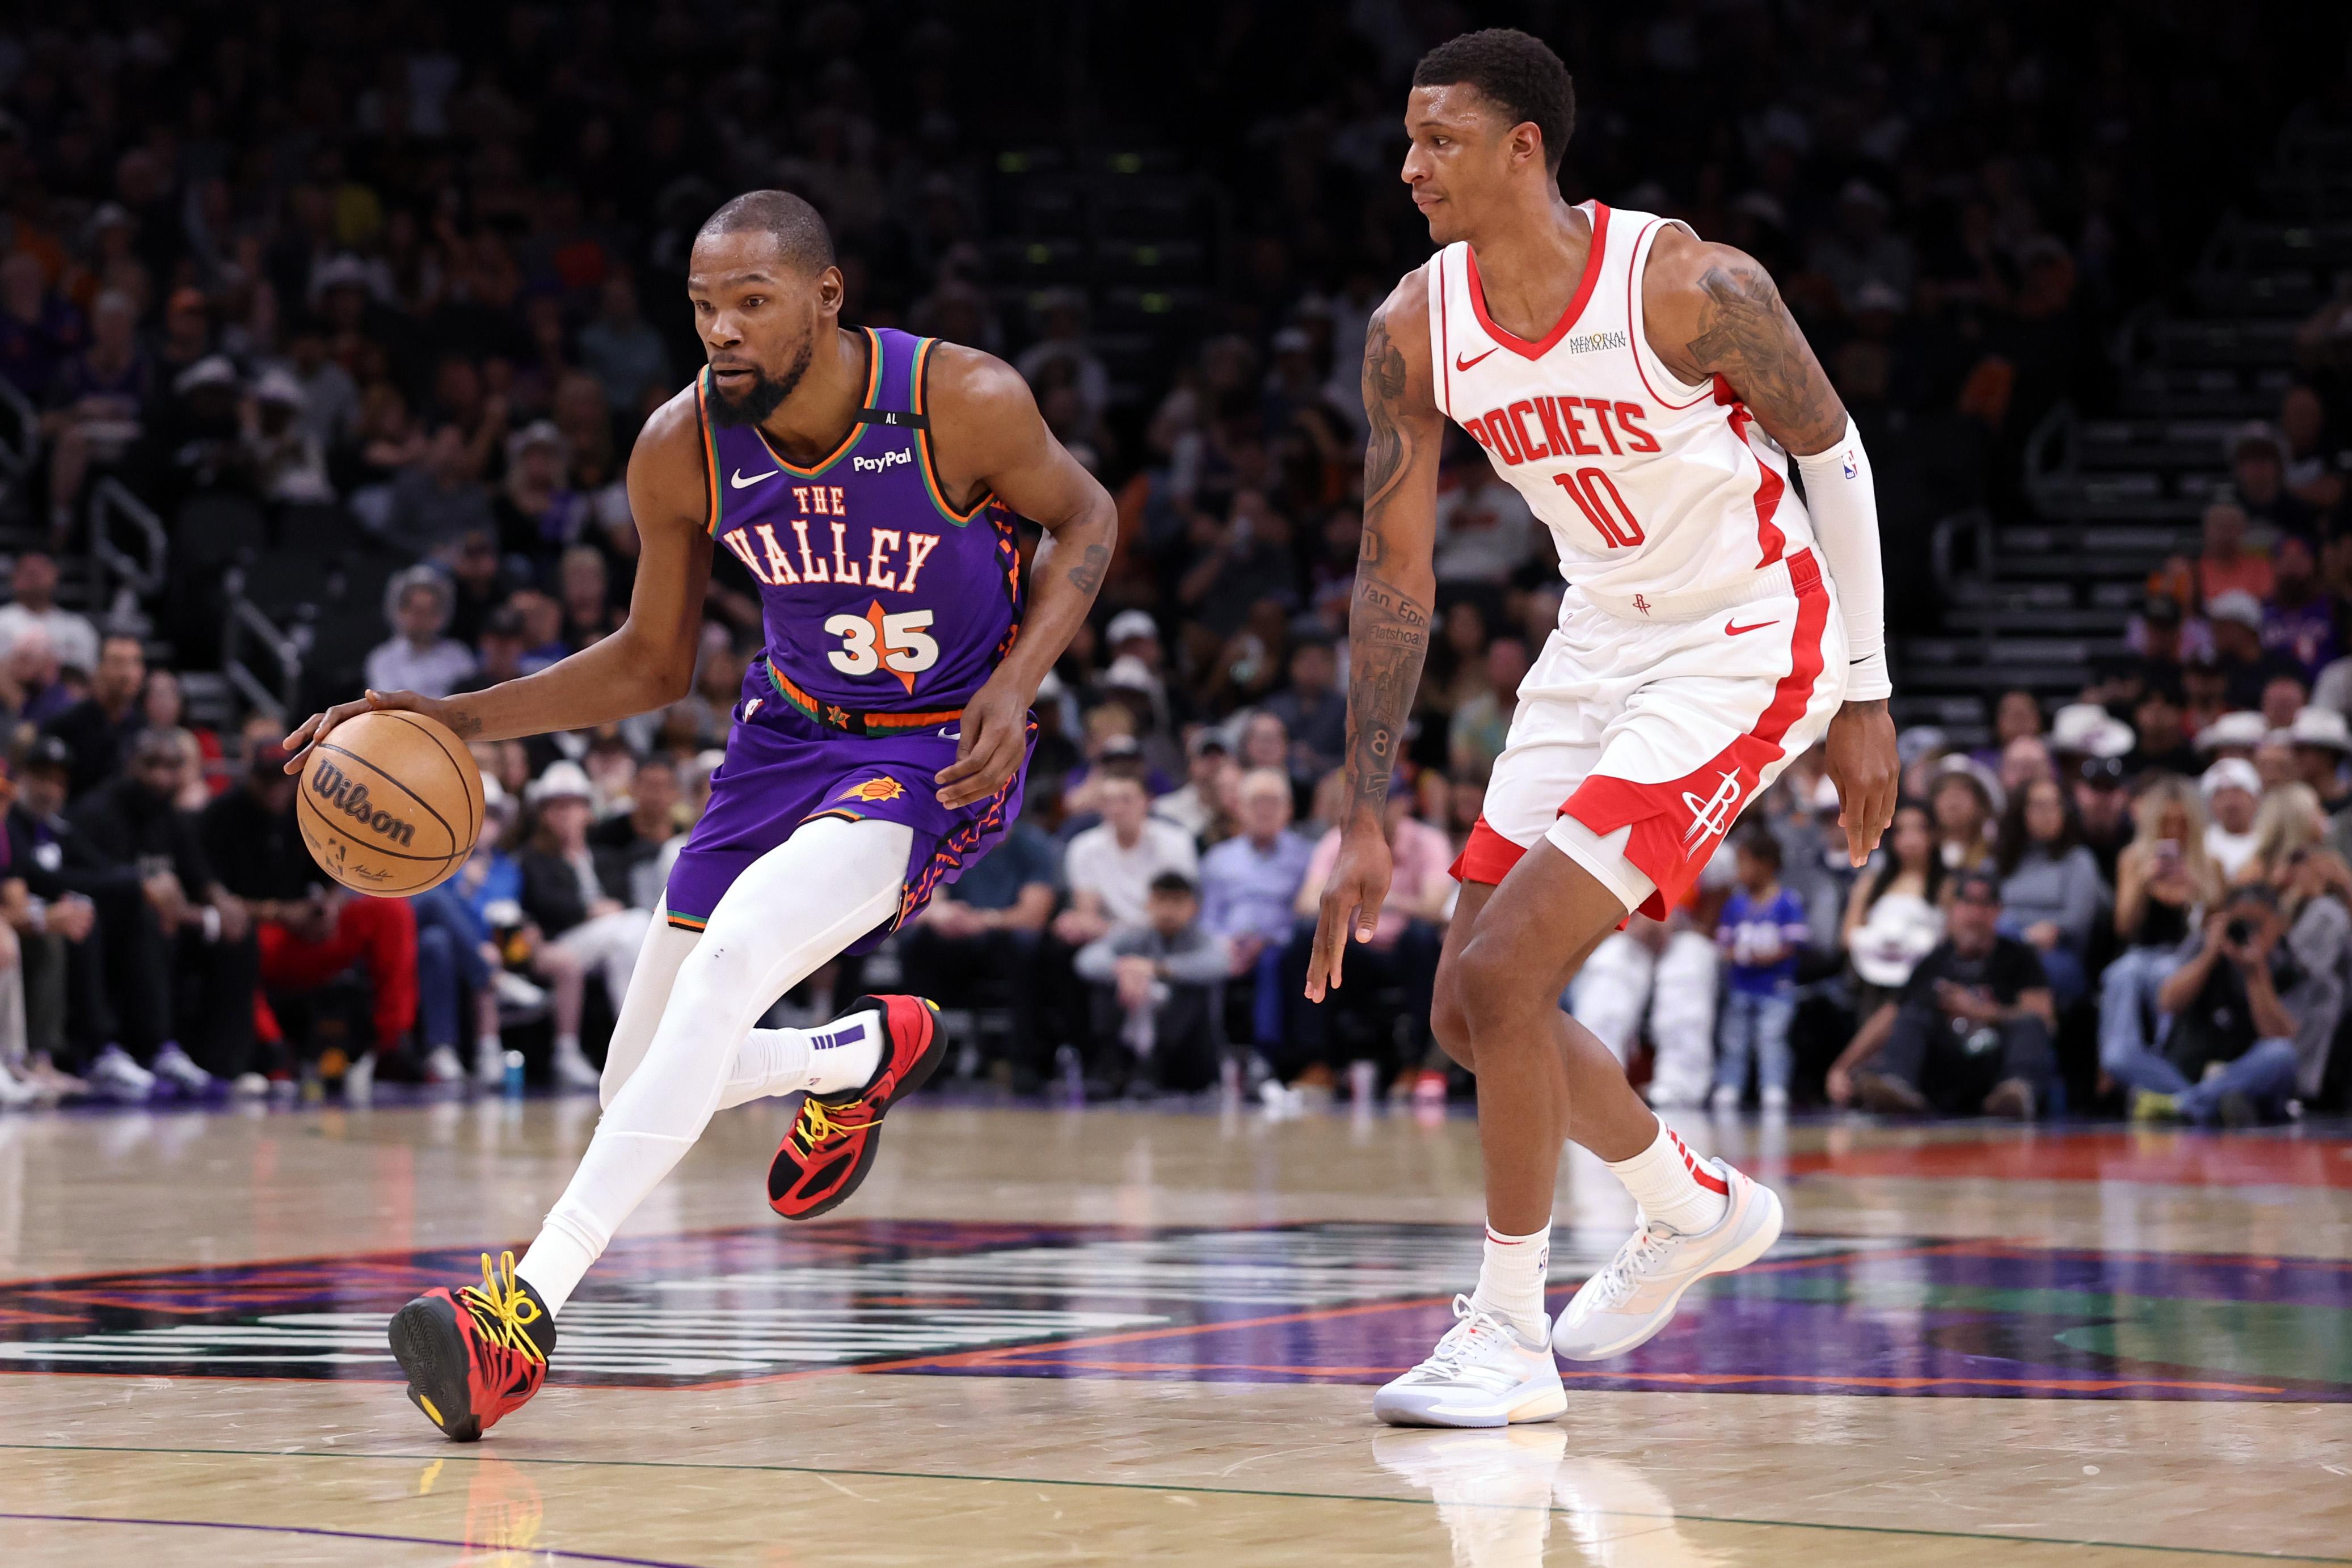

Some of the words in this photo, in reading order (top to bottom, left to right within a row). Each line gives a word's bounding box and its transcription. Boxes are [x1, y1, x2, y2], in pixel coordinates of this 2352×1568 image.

[1570, 331, 1626, 347] MEMORIAL
[1570, 338, 1626, 354] HERMANN
[886, 412, 897, 424] AL
[853, 447, 912, 473] PayPal
[792, 486, 845, 516] THE
[1553, 467, 1645, 548] 10
[723, 520, 940, 593] VALLEY
[823, 609, 939, 676] 35
[313, 757, 415, 848] Wilson
